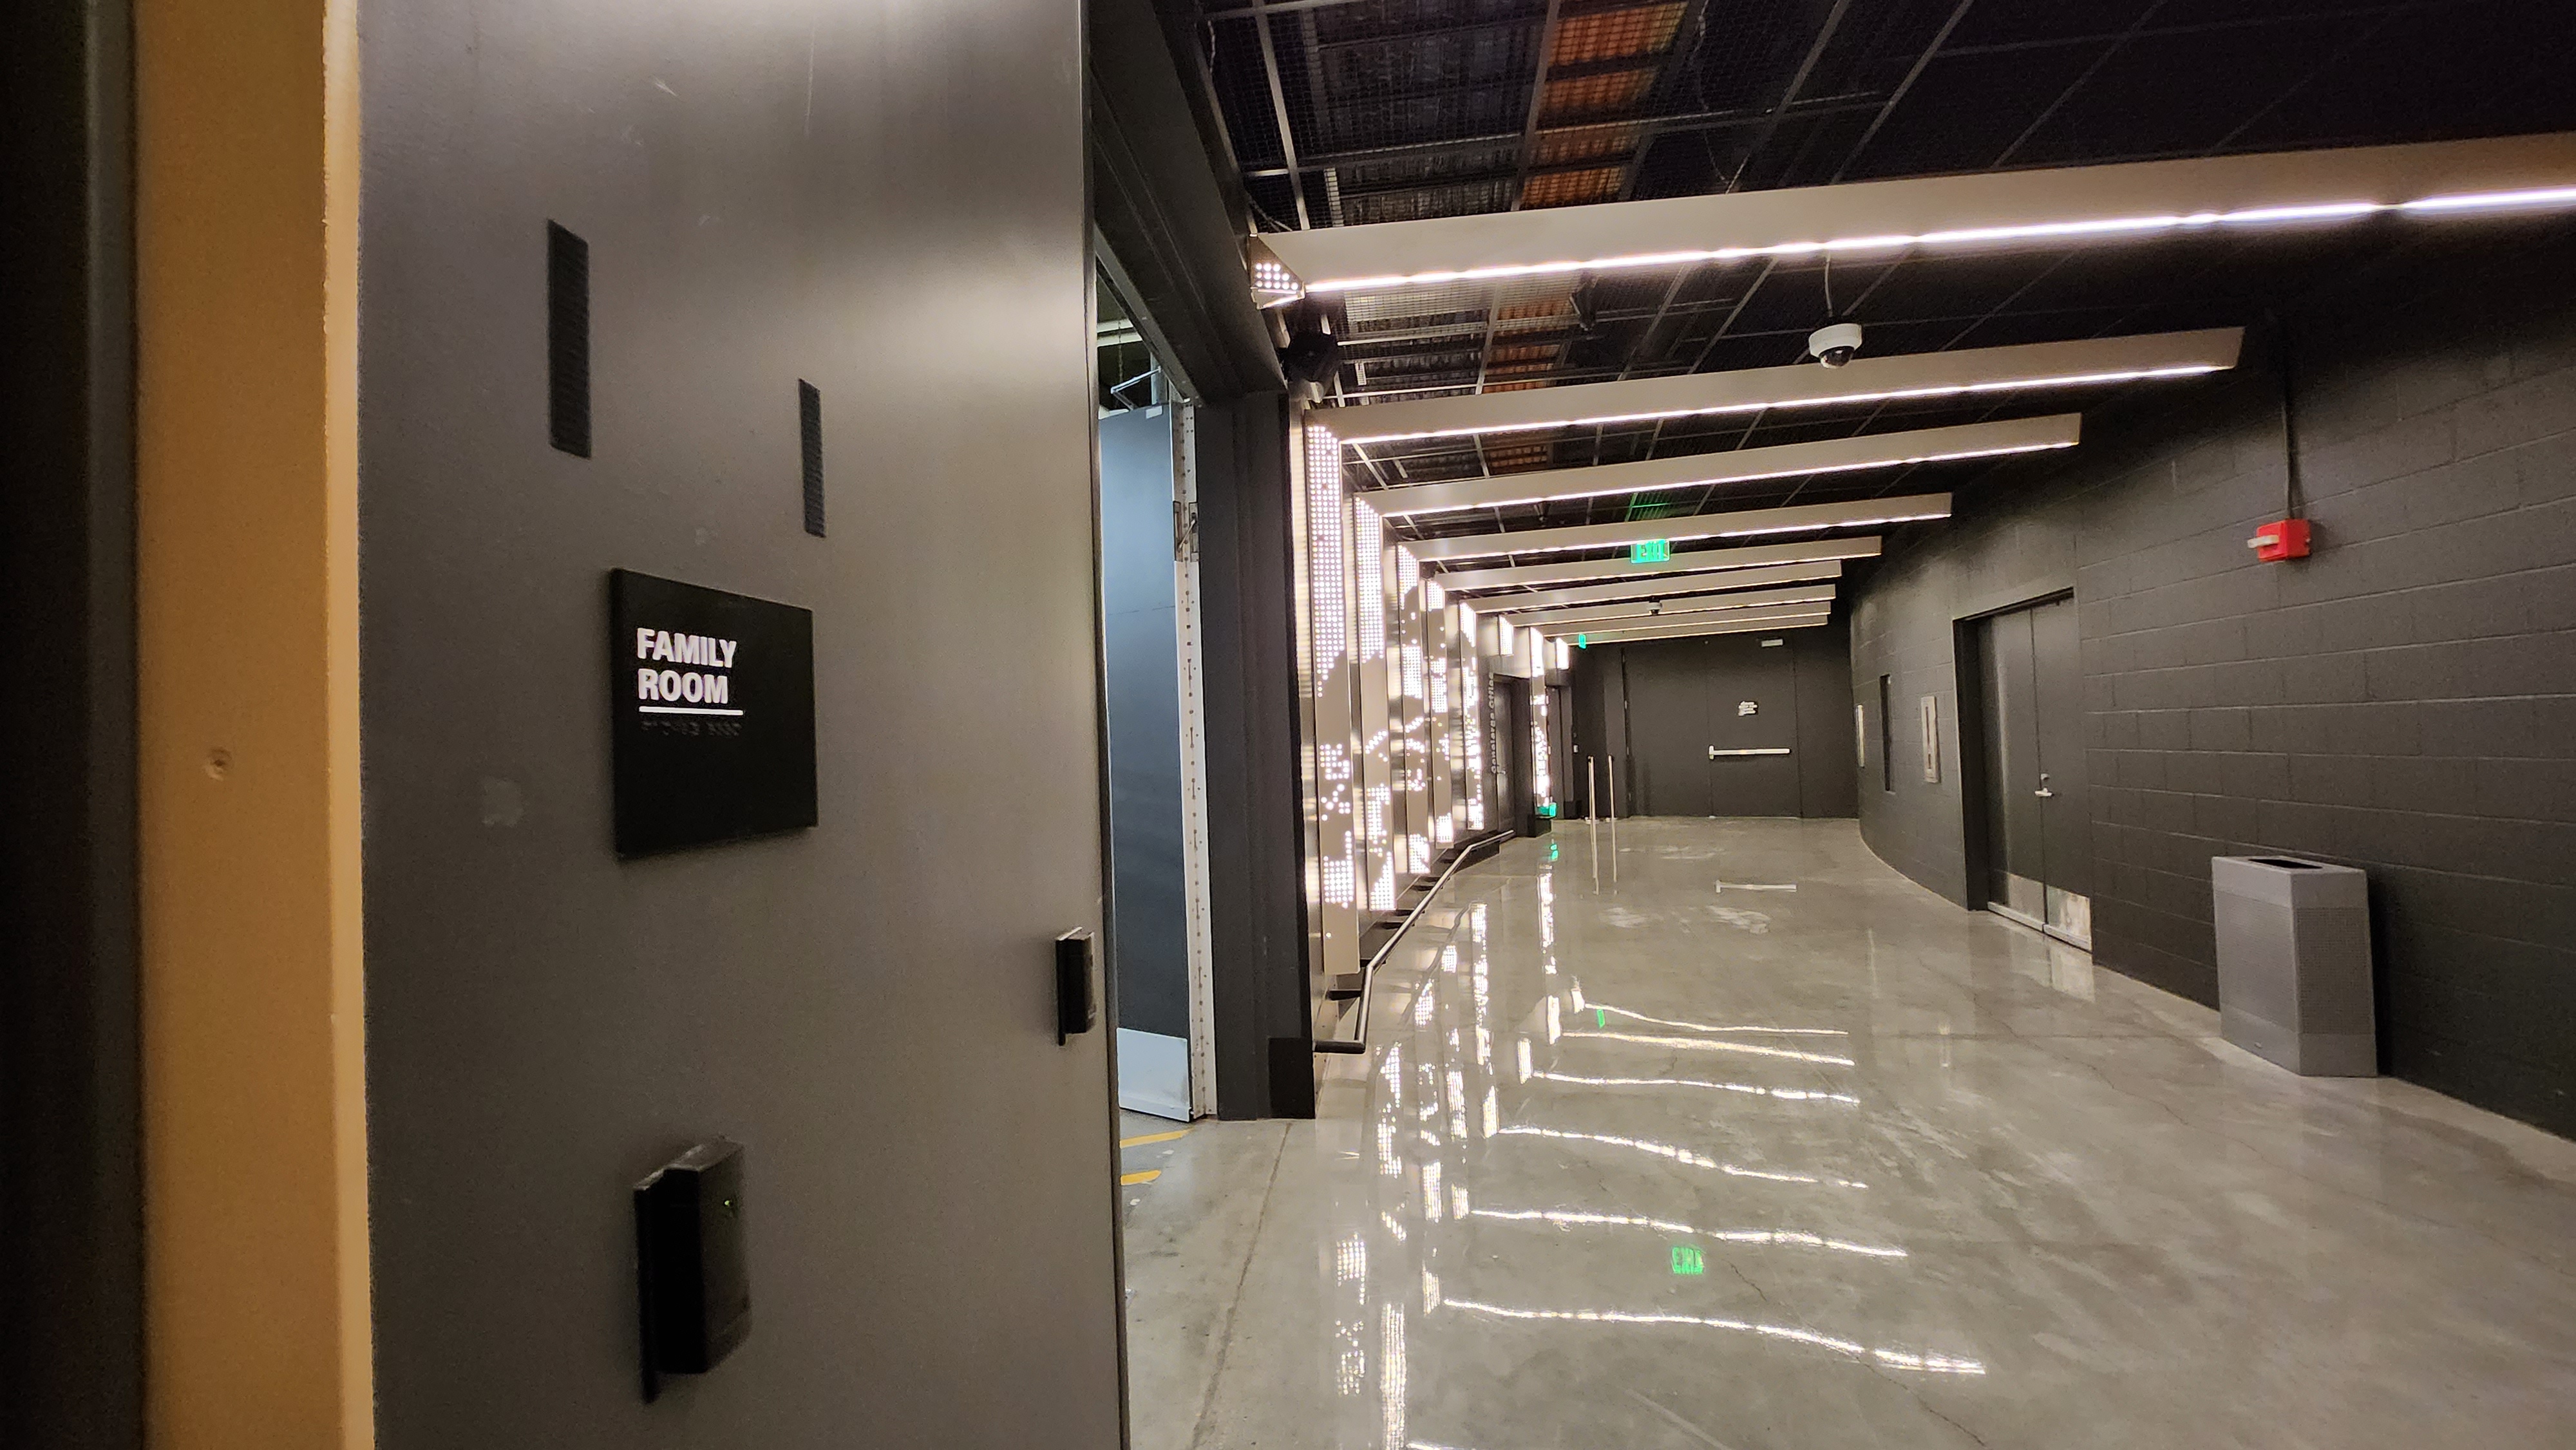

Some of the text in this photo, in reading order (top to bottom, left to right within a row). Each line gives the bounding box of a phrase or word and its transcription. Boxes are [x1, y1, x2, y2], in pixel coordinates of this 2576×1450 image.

[1636, 538, 1665, 562] EXIT
[637, 627, 737, 668] FAMILY
[638, 668, 728, 704] ROOM
